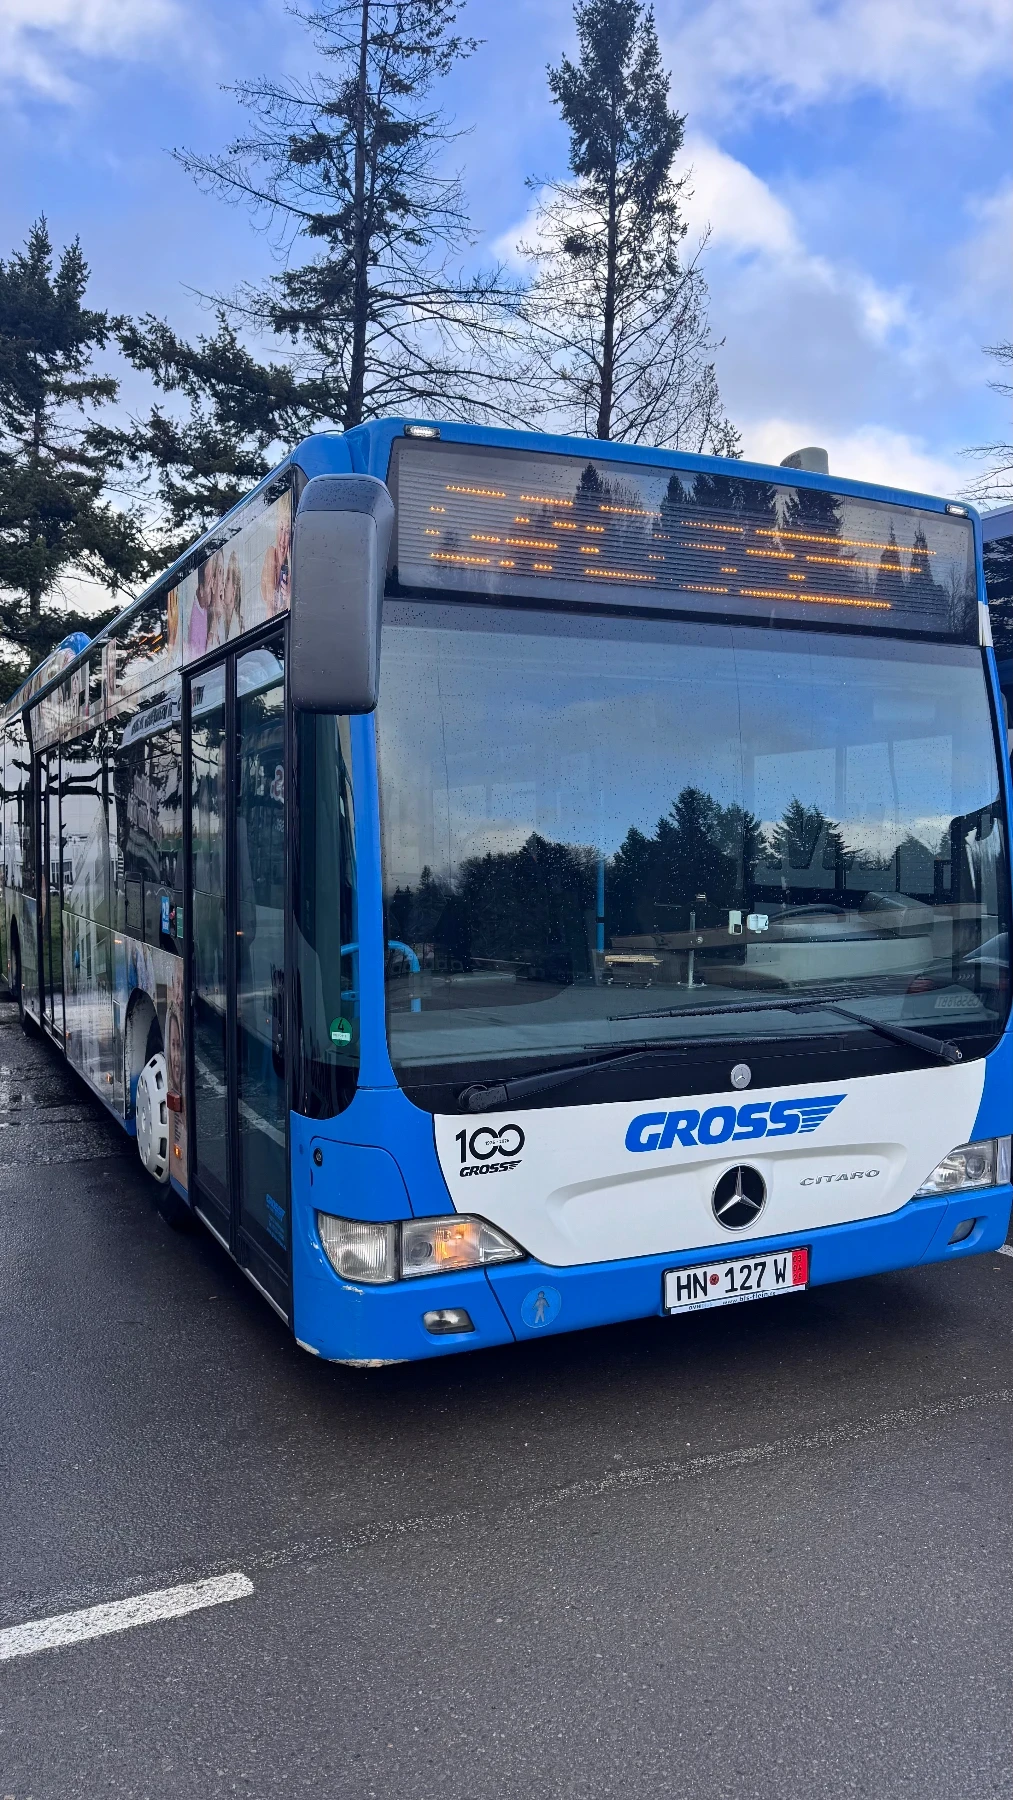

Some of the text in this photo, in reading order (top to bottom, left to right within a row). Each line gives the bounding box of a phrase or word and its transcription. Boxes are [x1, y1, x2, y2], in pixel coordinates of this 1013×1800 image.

[337, 1018, 345, 1032] 4
[625, 1094, 848, 1152] GROSS
[456, 1124, 525, 1163] 100
[460, 1160, 522, 1177] GROSS
[800, 1169, 880, 1186] CITARO
[676, 1257, 787, 1302] HN 127 W
